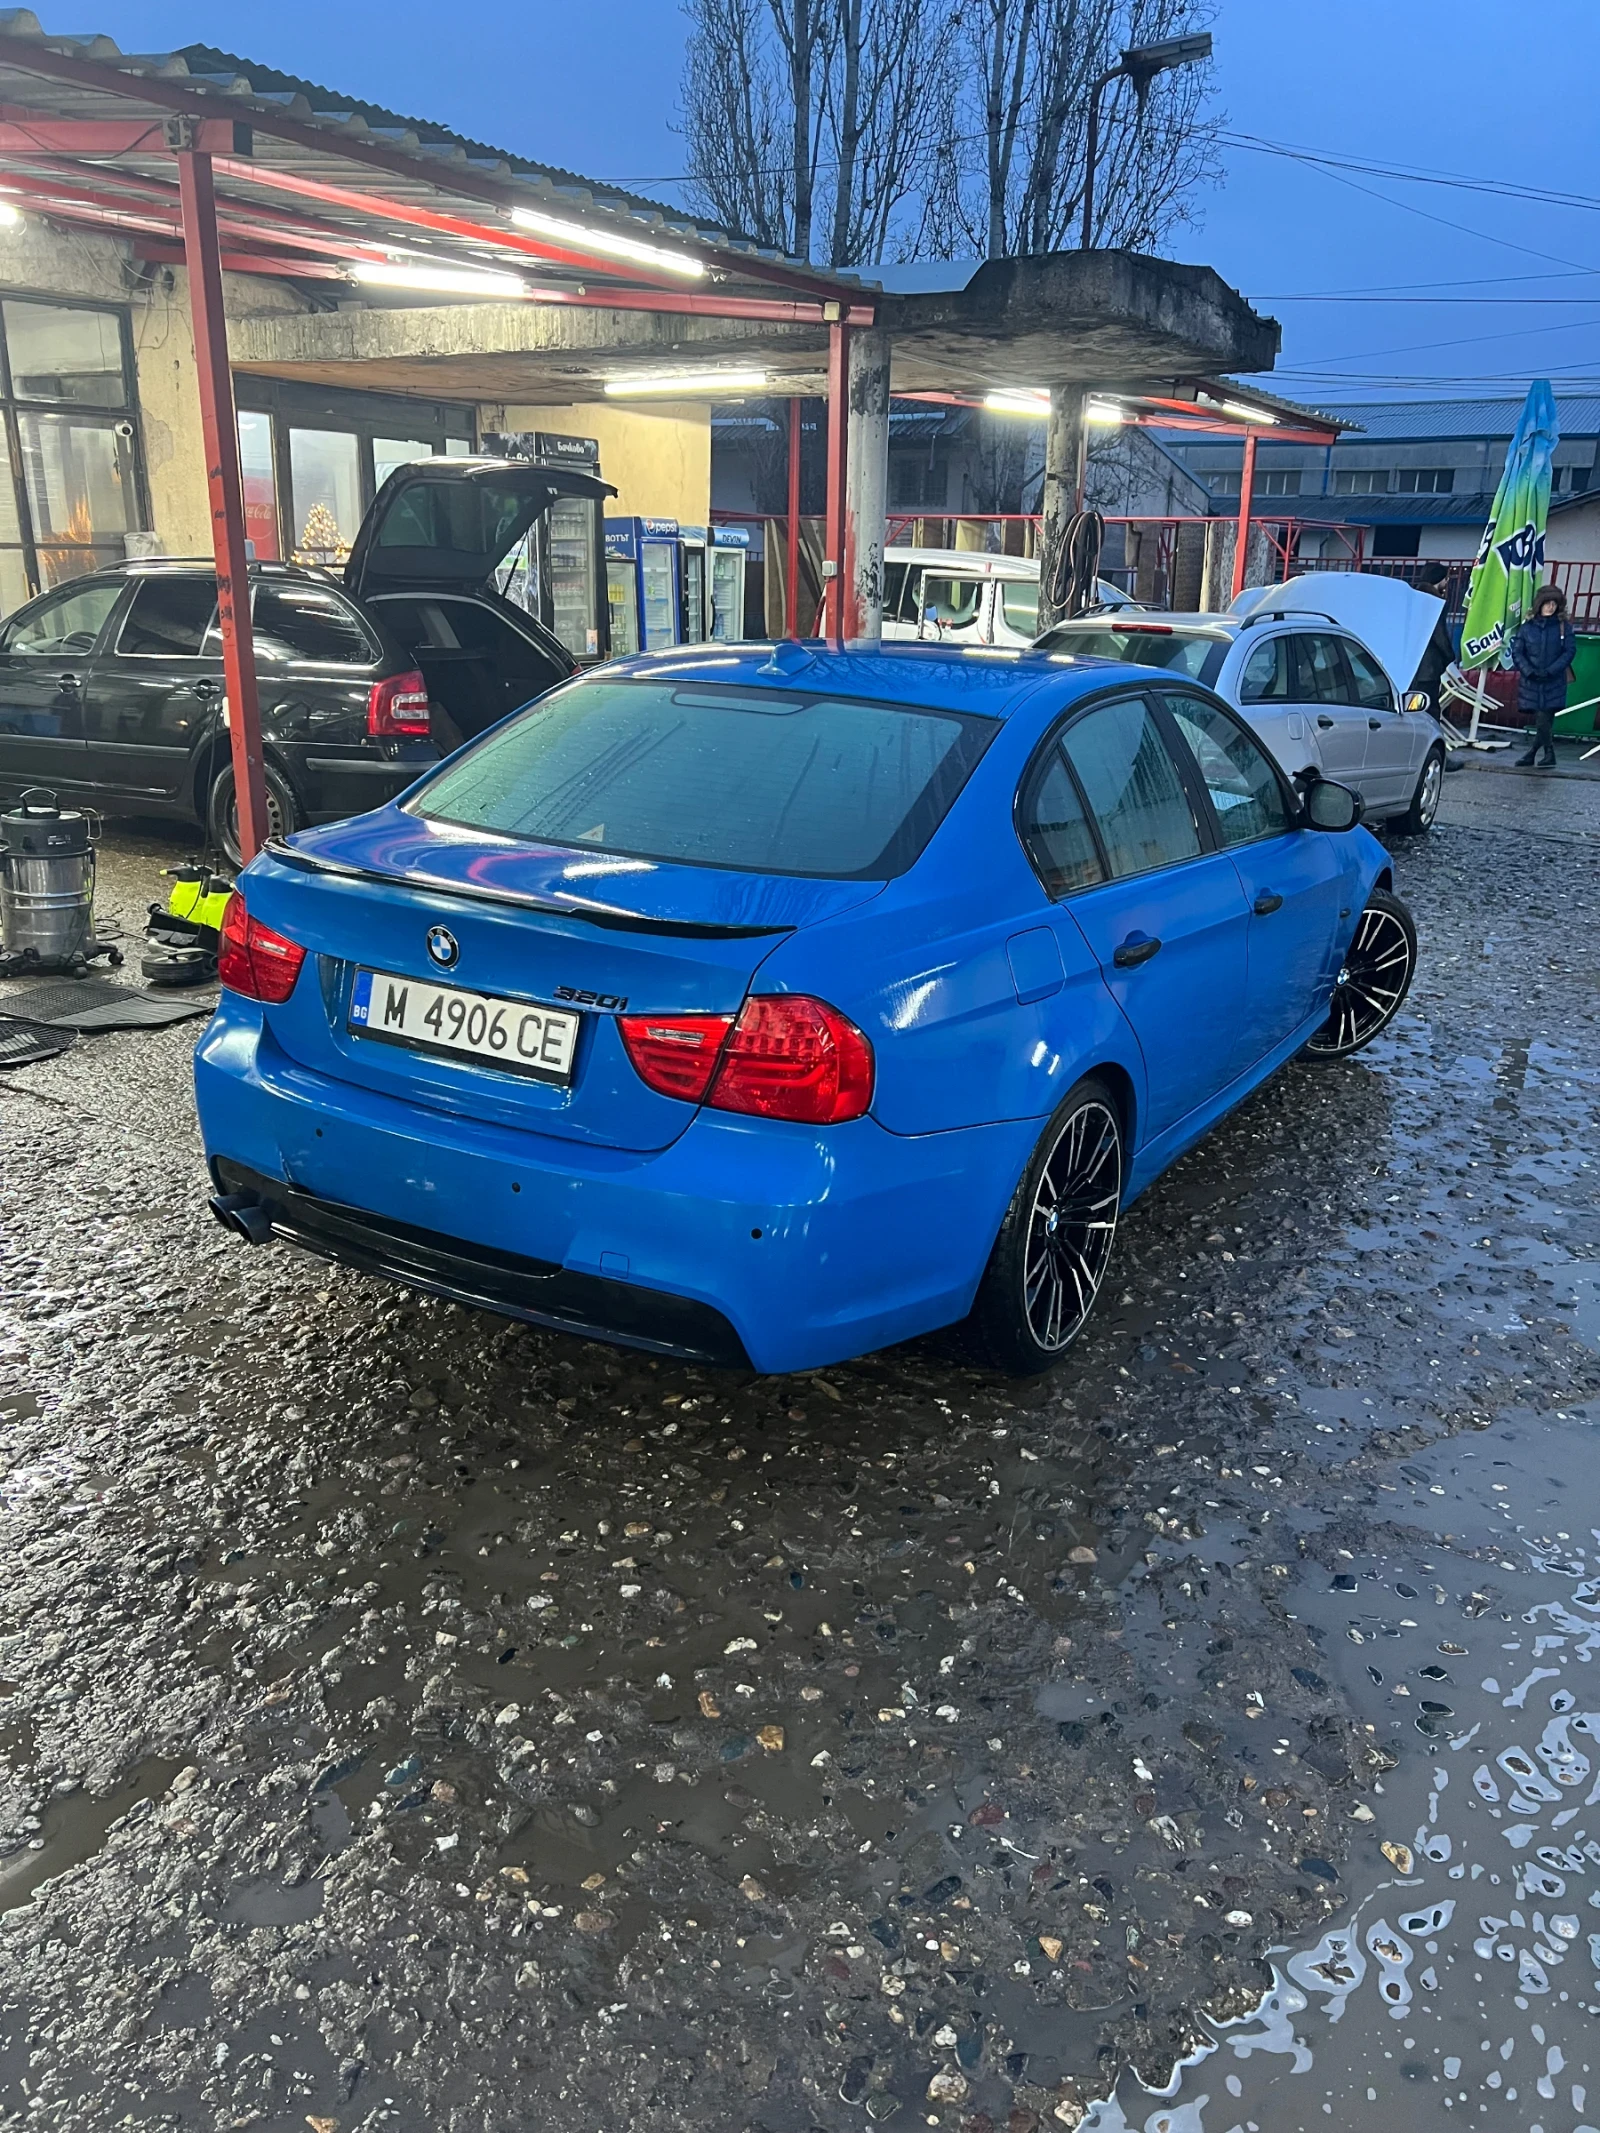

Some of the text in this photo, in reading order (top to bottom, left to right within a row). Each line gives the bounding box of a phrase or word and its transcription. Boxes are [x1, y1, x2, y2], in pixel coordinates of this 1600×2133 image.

[655, 521, 677, 534] pepsi
[604, 534, 630, 542] ВОТЪТ
[722, 534, 742, 545] DEVIN
[353, 1004, 368, 1019] BG
[383, 983, 567, 1065] M 4906 CE
